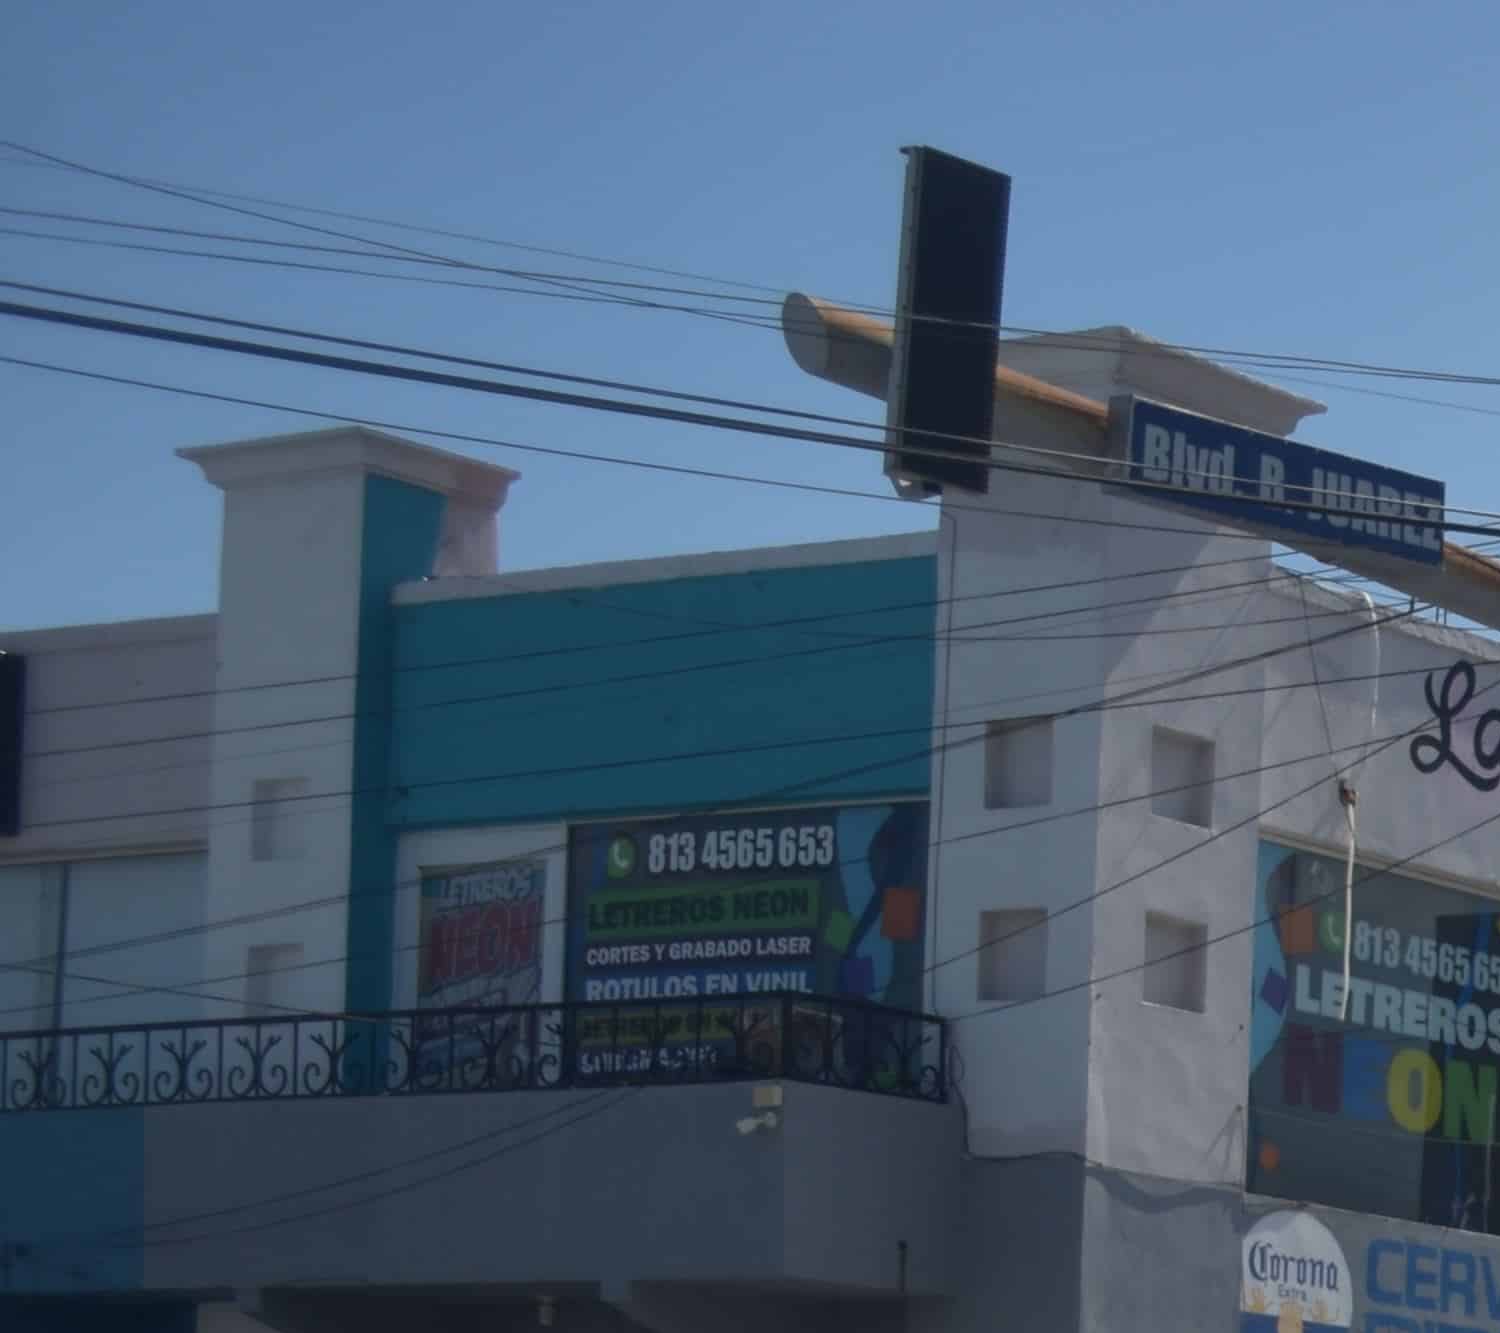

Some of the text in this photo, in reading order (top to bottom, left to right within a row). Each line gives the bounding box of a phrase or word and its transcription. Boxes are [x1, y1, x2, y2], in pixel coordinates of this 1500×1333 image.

[1143, 423, 1441, 550] Blvd. R. JUAREZ
[648, 824, 835, 873] 813 4565 653
[588, 885, 810, 933] LETREROS NEON
[586, 935, 812, 966] CORTES Y GRABADO LASER
[1354, 920, 1401, 968] 813
[1404, 936, 1470, 987] 4565
[585, 969, 813, 1002] ROTULOS EN VINIL
[1282, 1022, 1498, 1146] NEON
[1248, 1239, 1339, 1292] Corona
